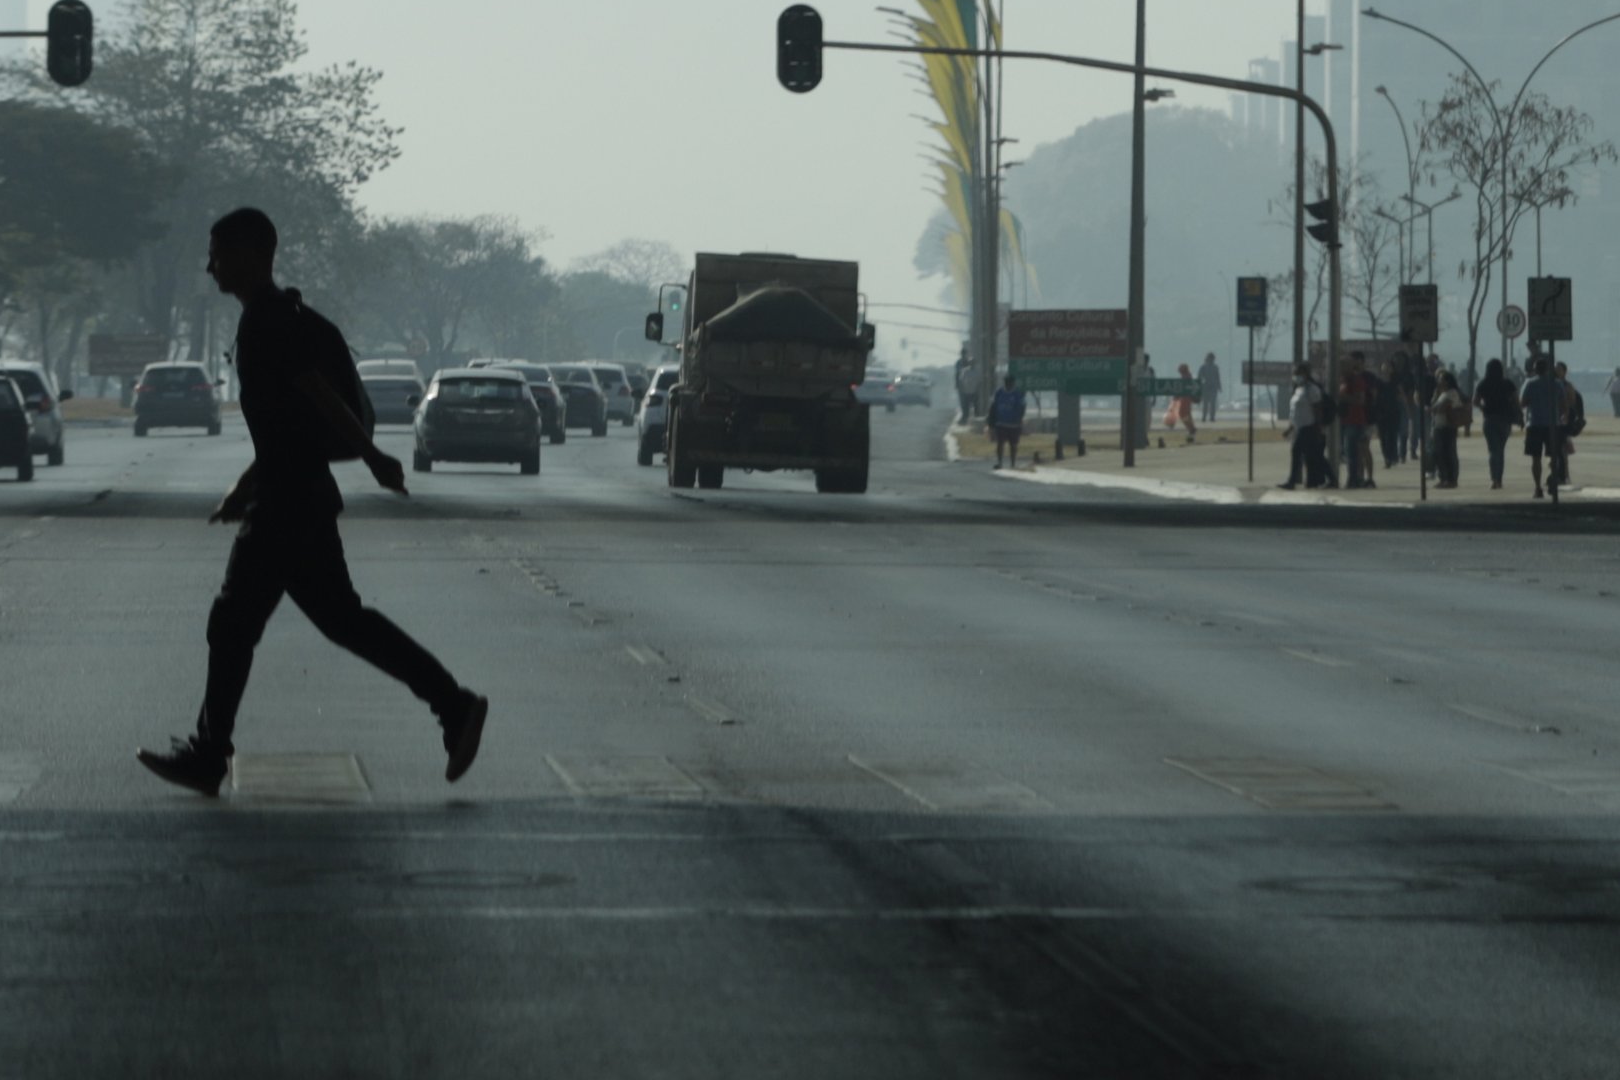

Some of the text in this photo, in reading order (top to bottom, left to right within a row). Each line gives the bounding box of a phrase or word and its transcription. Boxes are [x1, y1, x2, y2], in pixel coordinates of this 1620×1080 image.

[1066, 310, 1115, 322] Cultural
[1030, 327, 1047, 338] da
[1021, 343, 1110, 354] Cultural Center
[1047, 359, 1062, 371] de
[1066, 358, 1111, 371] Cultura
